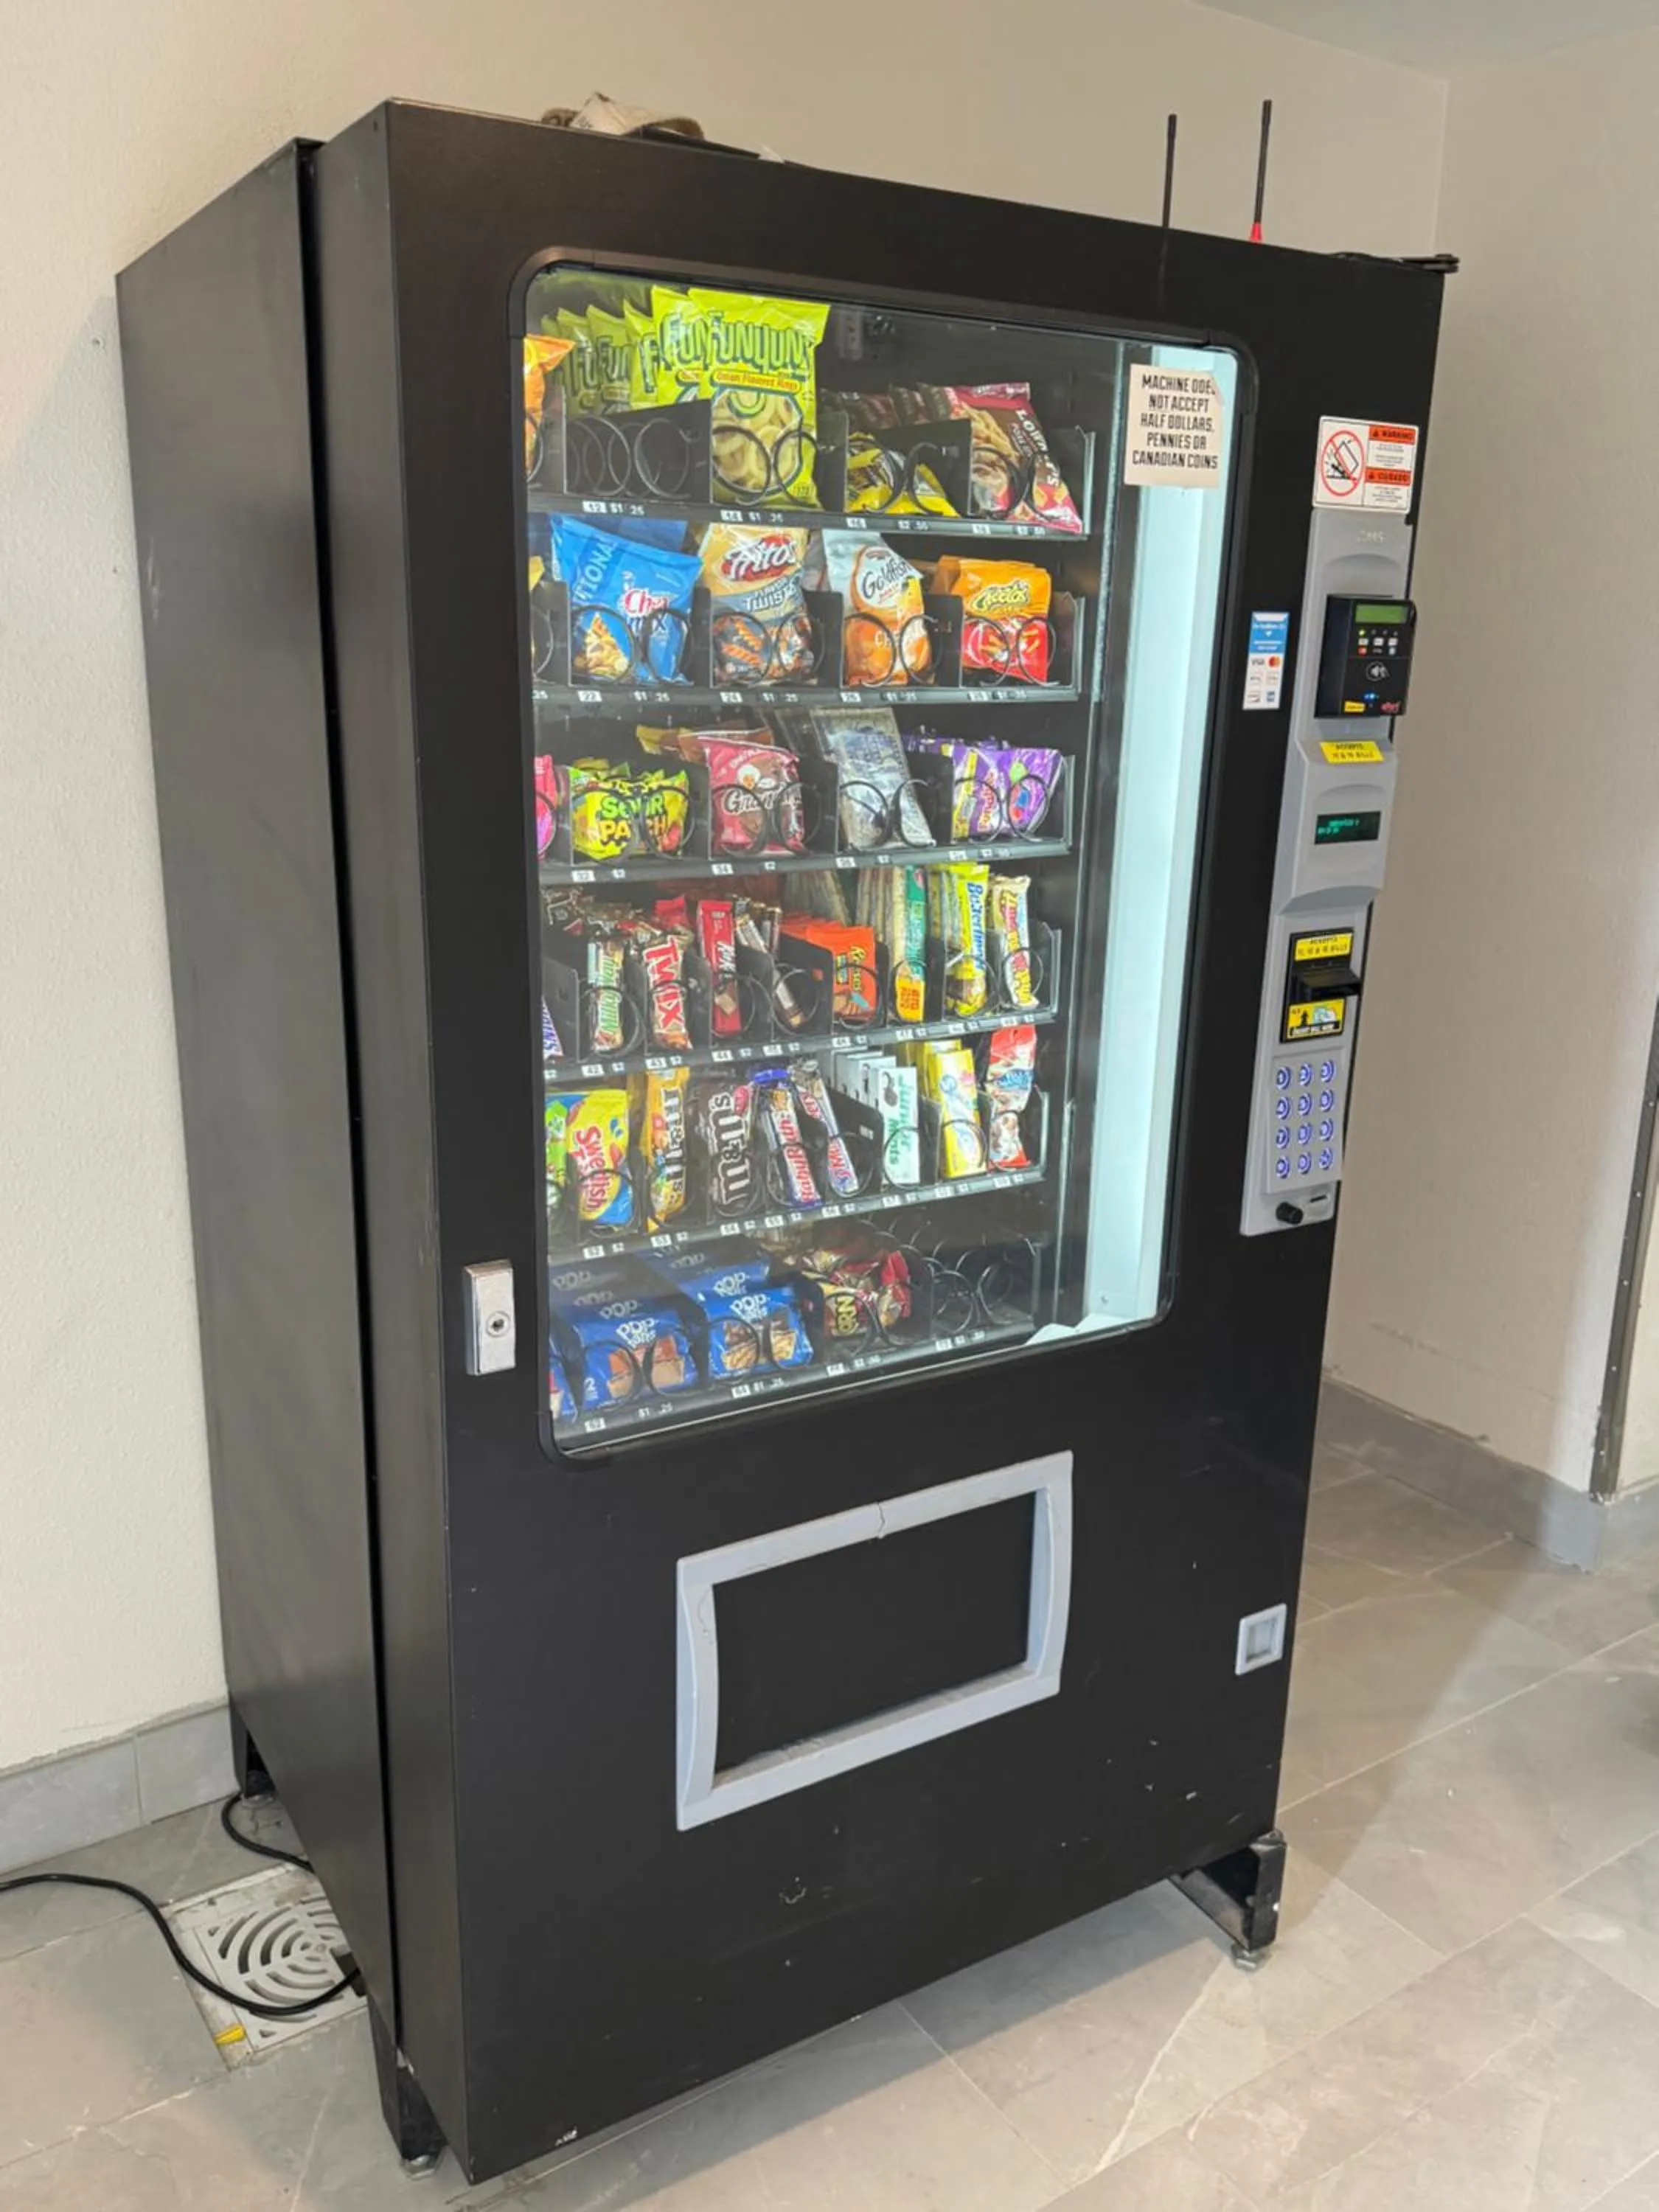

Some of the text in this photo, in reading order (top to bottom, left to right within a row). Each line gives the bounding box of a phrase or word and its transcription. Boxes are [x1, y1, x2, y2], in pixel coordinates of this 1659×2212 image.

[1142, 374, 1216, 395] MACHINE DOE
[1149, 394, 1209, 413] NOT ACCEPT
[1141, 413, 1166, 428] HALF
[1147, 432, 1207, 450] PENNIES OR
[1133, 450, 1218, 469] CANADIAN COINS
